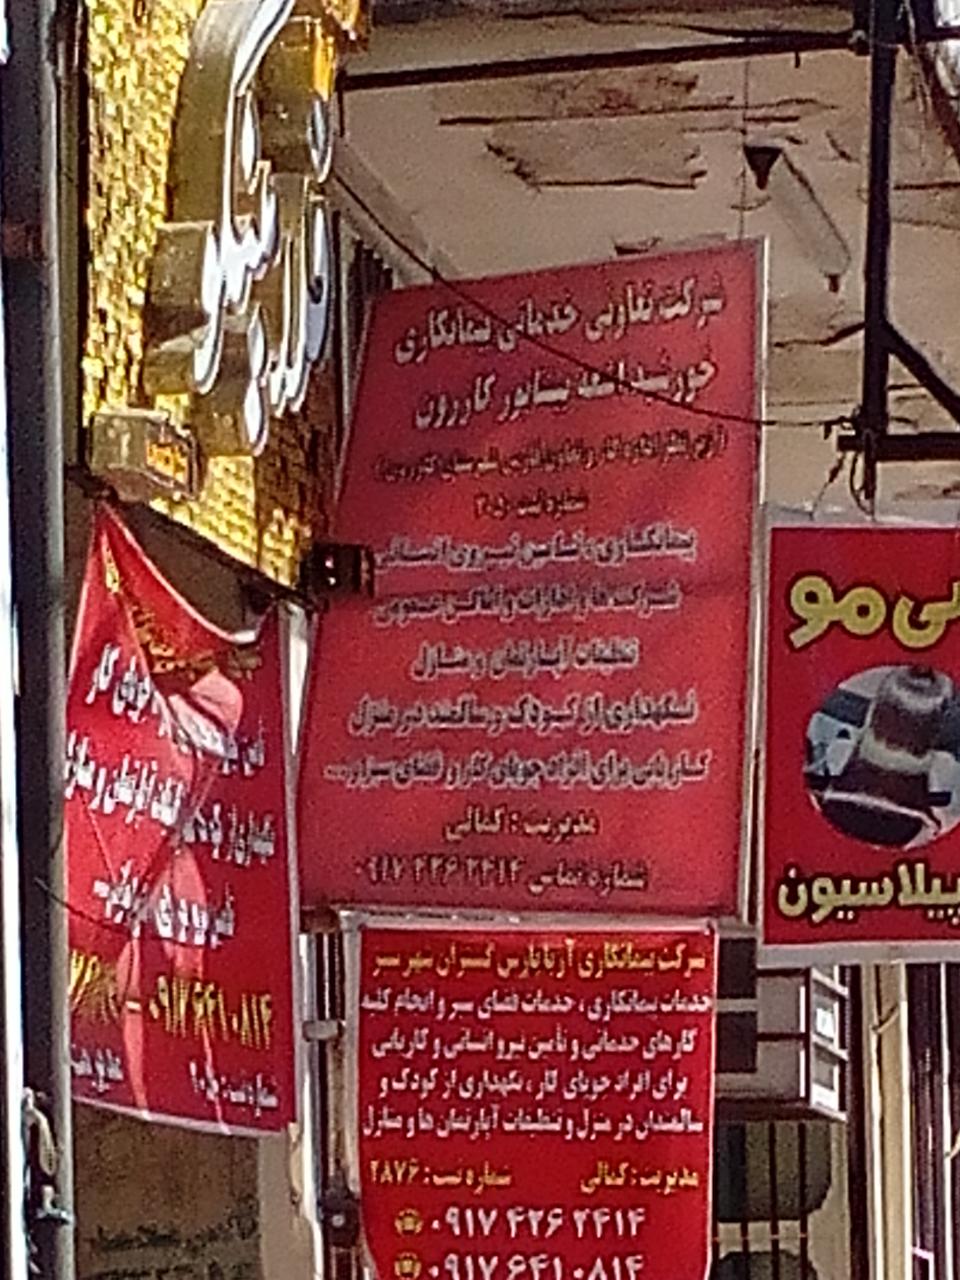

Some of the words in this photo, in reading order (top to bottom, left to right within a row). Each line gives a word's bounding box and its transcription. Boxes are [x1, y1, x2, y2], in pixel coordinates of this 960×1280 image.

[584, 283, 656, 343] تعاونی
[657, 272, 728, 330] شرکت
[391, 306, 493, 366] پیمانکاری
[496, 291, 582, 353] خدماتی
[787, 572, 888, 652] مو
[444, 802, 504, 842] کمالی
[525, 858, 583, 893] تماس
[585, 859, 650, 896] شماره
[578, 940, 657, 979] پیمانکاری
[657, 942, 707, 978] شرکت
[520, 987, 576, 1015] خدمات
[659, 987, 713, 1015] خدمات
[442, 1028, 495, 1060] انسانی
[581, 1028, 641, 1061] خدماتی
[378, 1076, 390, 1100] و
[391, 1066, 441, 1101] کودک
[459, 1067, 525, 1101] نگهداری
[535, 1067, 560, 1101] کار
[562, 1069, 612, 1101] جویای
[613, 1067, 651, 1101] افراد
[651, 1067, 689, 1101] برای
[361, 1104, 403, 1140] منازل
[575, 1106, 613, 1142] منزل
[613, 1112, 634, 1142] در
[635, 1107, 704, 1141] سالمندان
[466, 1159, 513, 1196] شماره
[580, 1161, 631, 1196] کمالی
[431, 1204, 499, 1239] ۰۹۱۷
